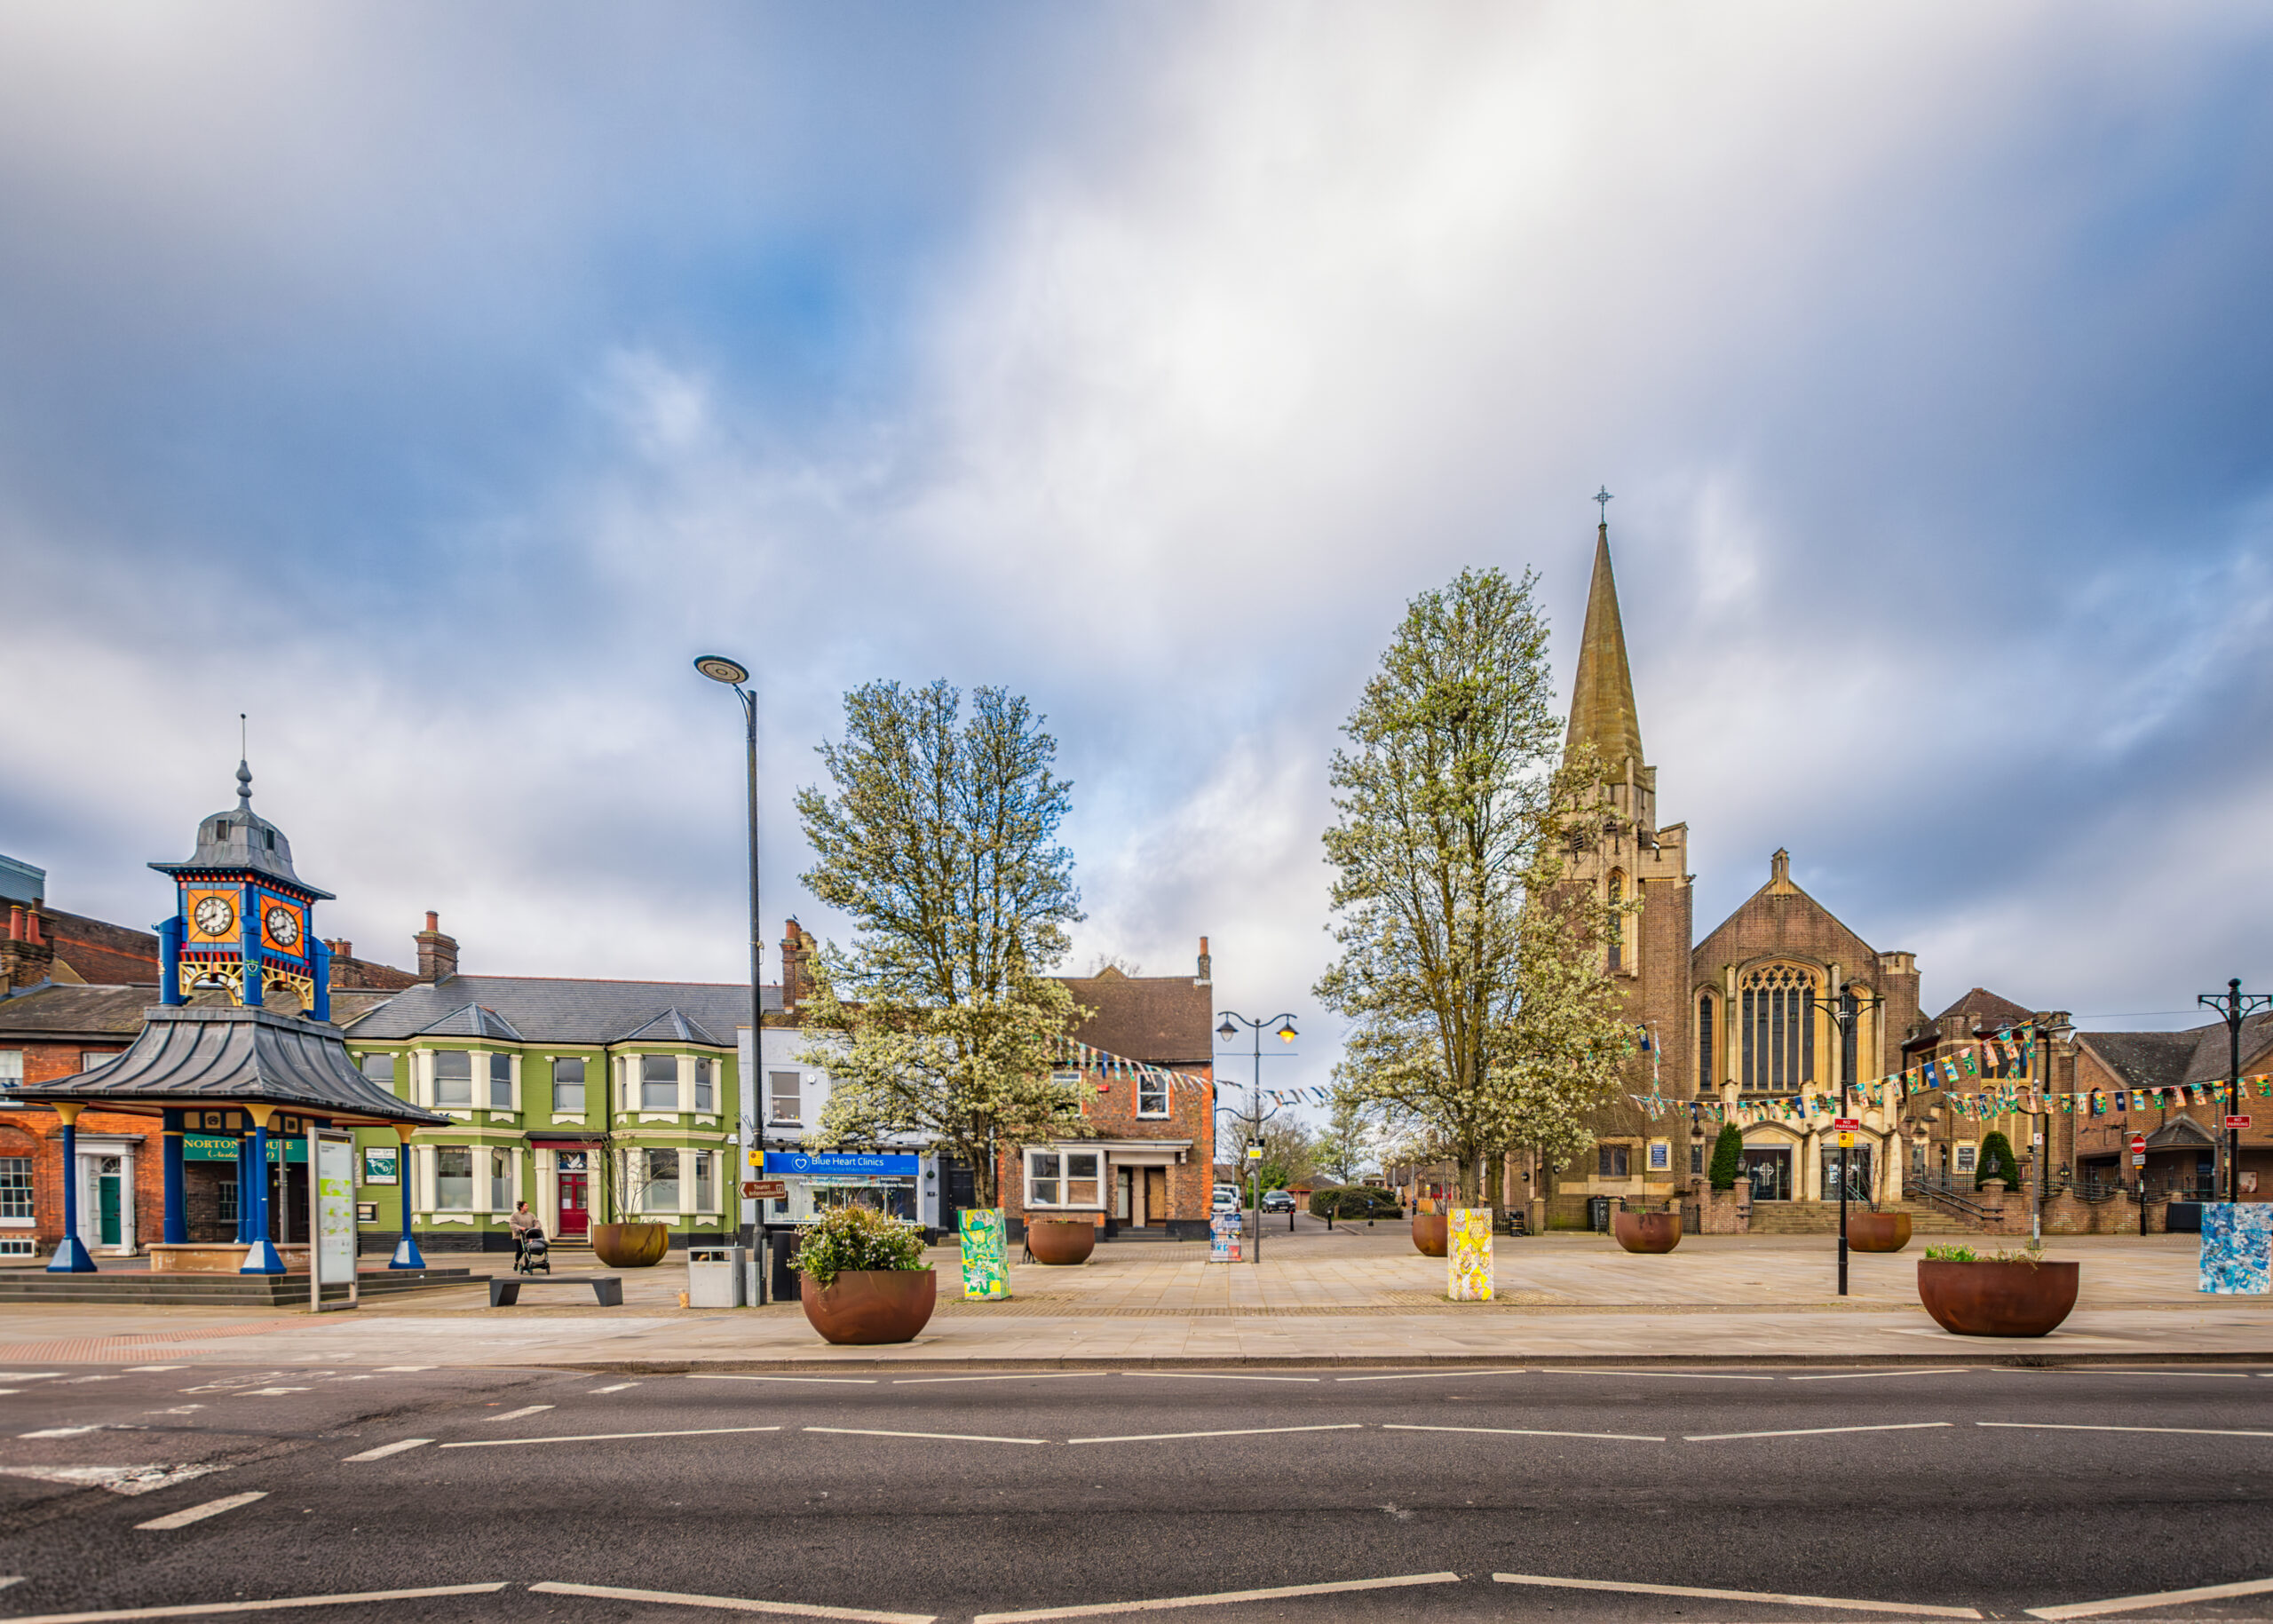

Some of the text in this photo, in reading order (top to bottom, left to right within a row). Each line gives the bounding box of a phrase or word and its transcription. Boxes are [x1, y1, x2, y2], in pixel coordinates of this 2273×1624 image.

[184, 1139, 238, 1149] NORTON
[812, 1156, 883, 1166] Blue Heart Clinics
